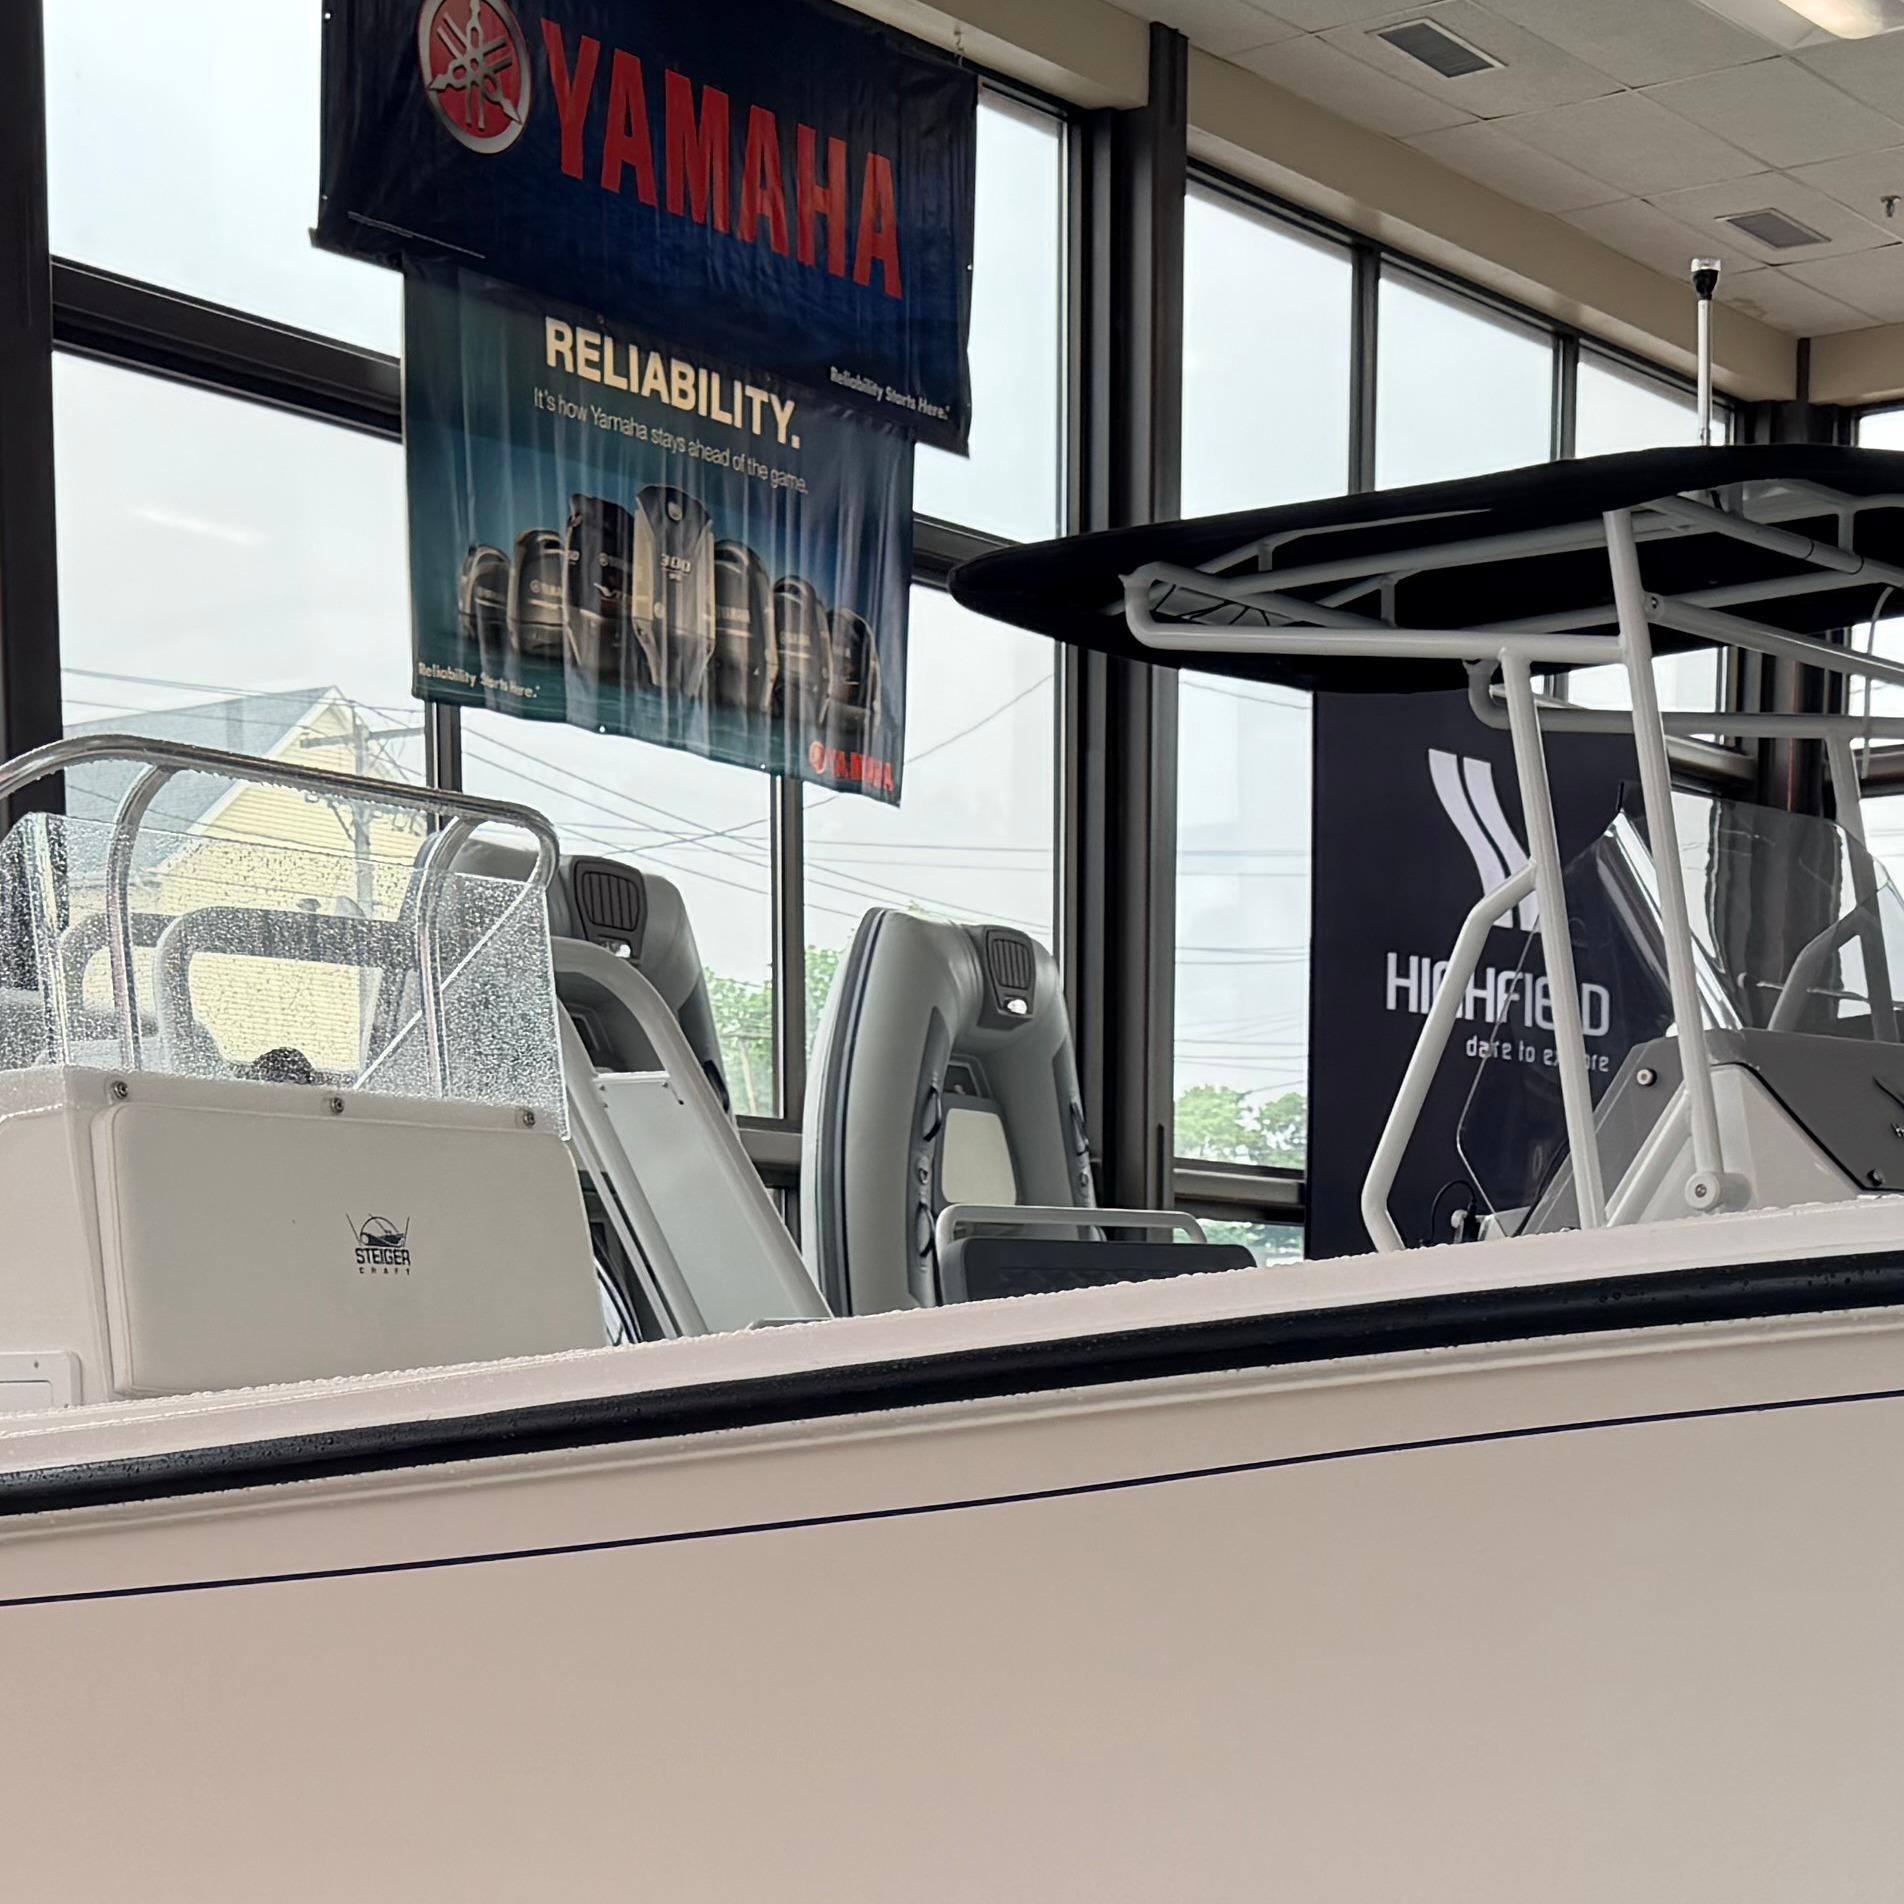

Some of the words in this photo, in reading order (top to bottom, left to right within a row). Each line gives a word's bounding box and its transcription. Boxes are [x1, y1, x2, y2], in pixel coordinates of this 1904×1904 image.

[541, 18, 903, 299] YAMAHA
[545, 316, 800, 450] RELIABILITY.
[534, 387, 556, 411] It's
[557, 393, 587, 422] how
[590, 405, 648, 441] Yamaha
[650, 427, 686, 454] stays
[687, 440, 730, 468] ahead
[732, 453, 746, 471] of
[746, 458, 769, 480] the
[1386, 952, 1610, 1036] HIHFIED
[1519, 1040, 1536, 1063] to
[355, 1248, 411, 1266] STEIGER
